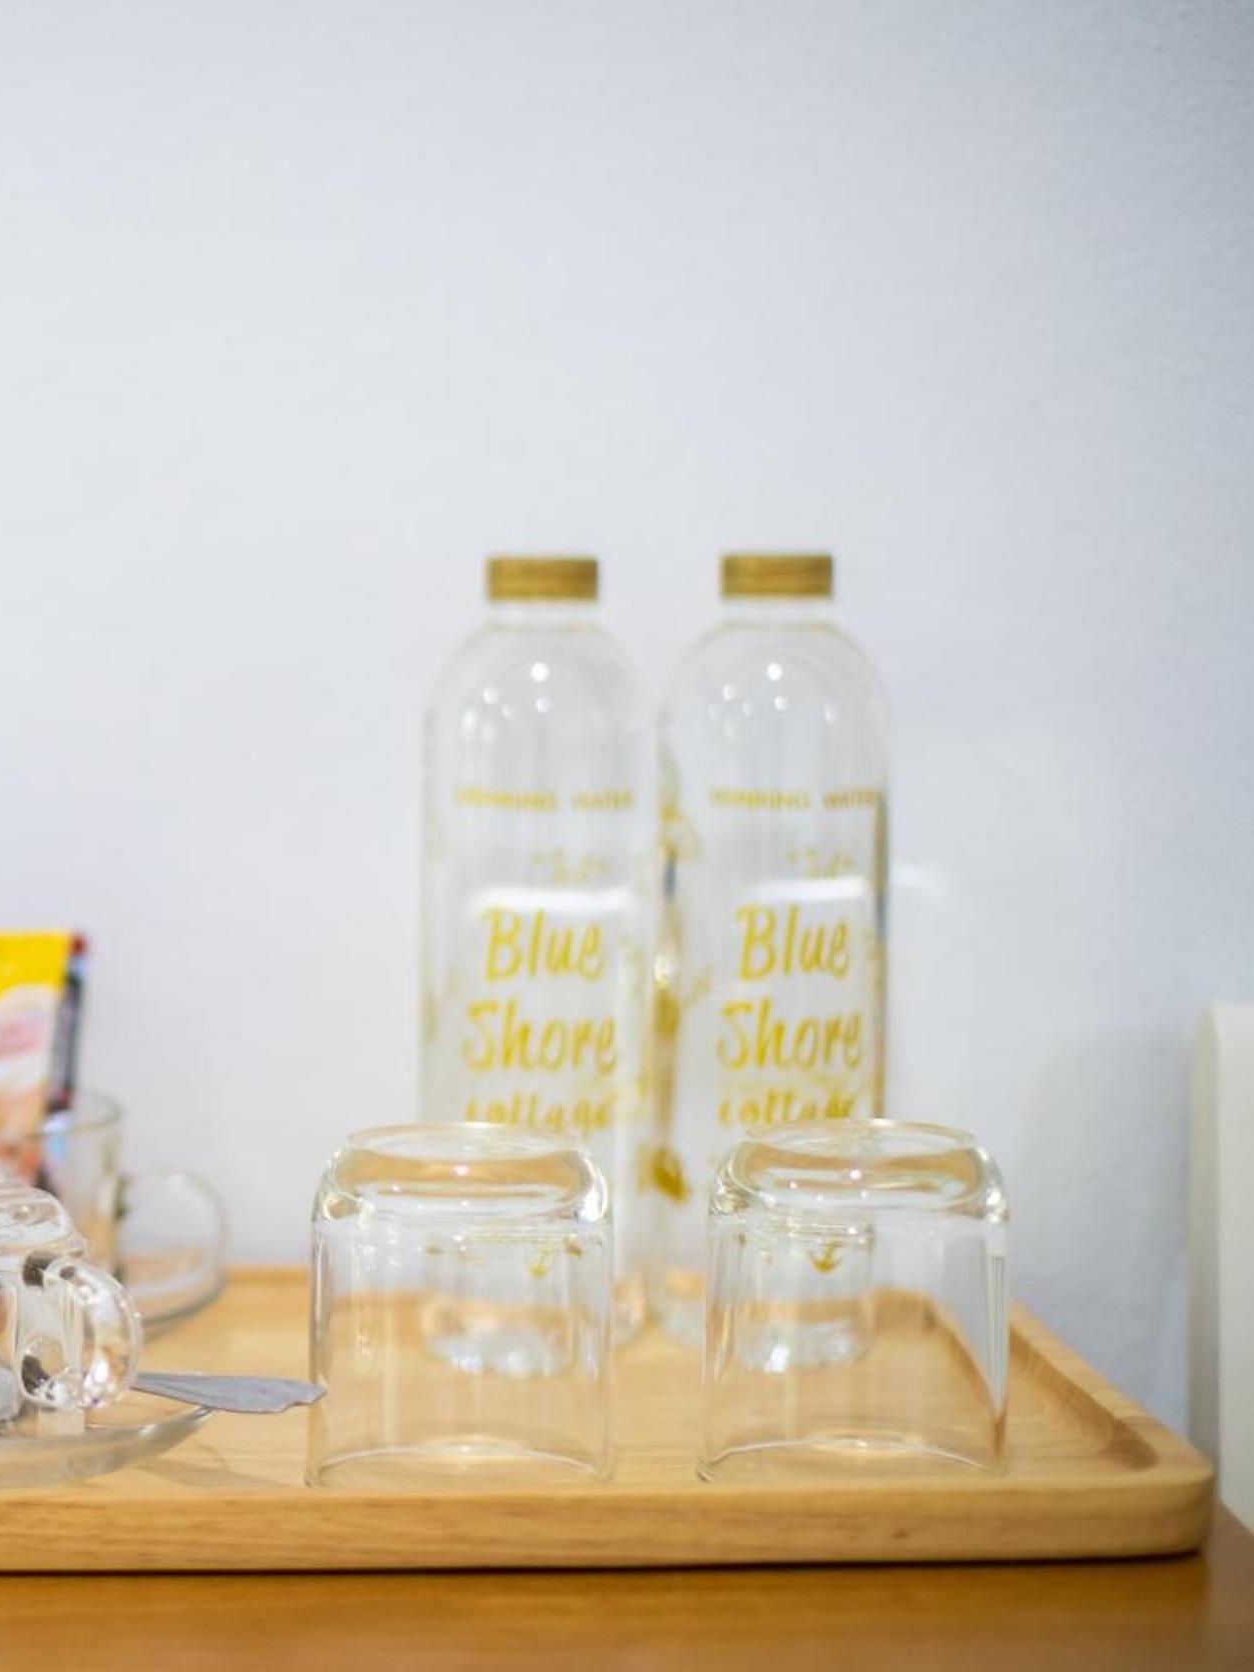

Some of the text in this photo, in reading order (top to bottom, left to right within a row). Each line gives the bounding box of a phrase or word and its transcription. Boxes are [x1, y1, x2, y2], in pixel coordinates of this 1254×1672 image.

[484, 904, 603, 983] Blue
[734, 902, 849, 982] Blue
[461, 997, 616, 1074] Shore
[716, 996, 862, 1070] Shore
